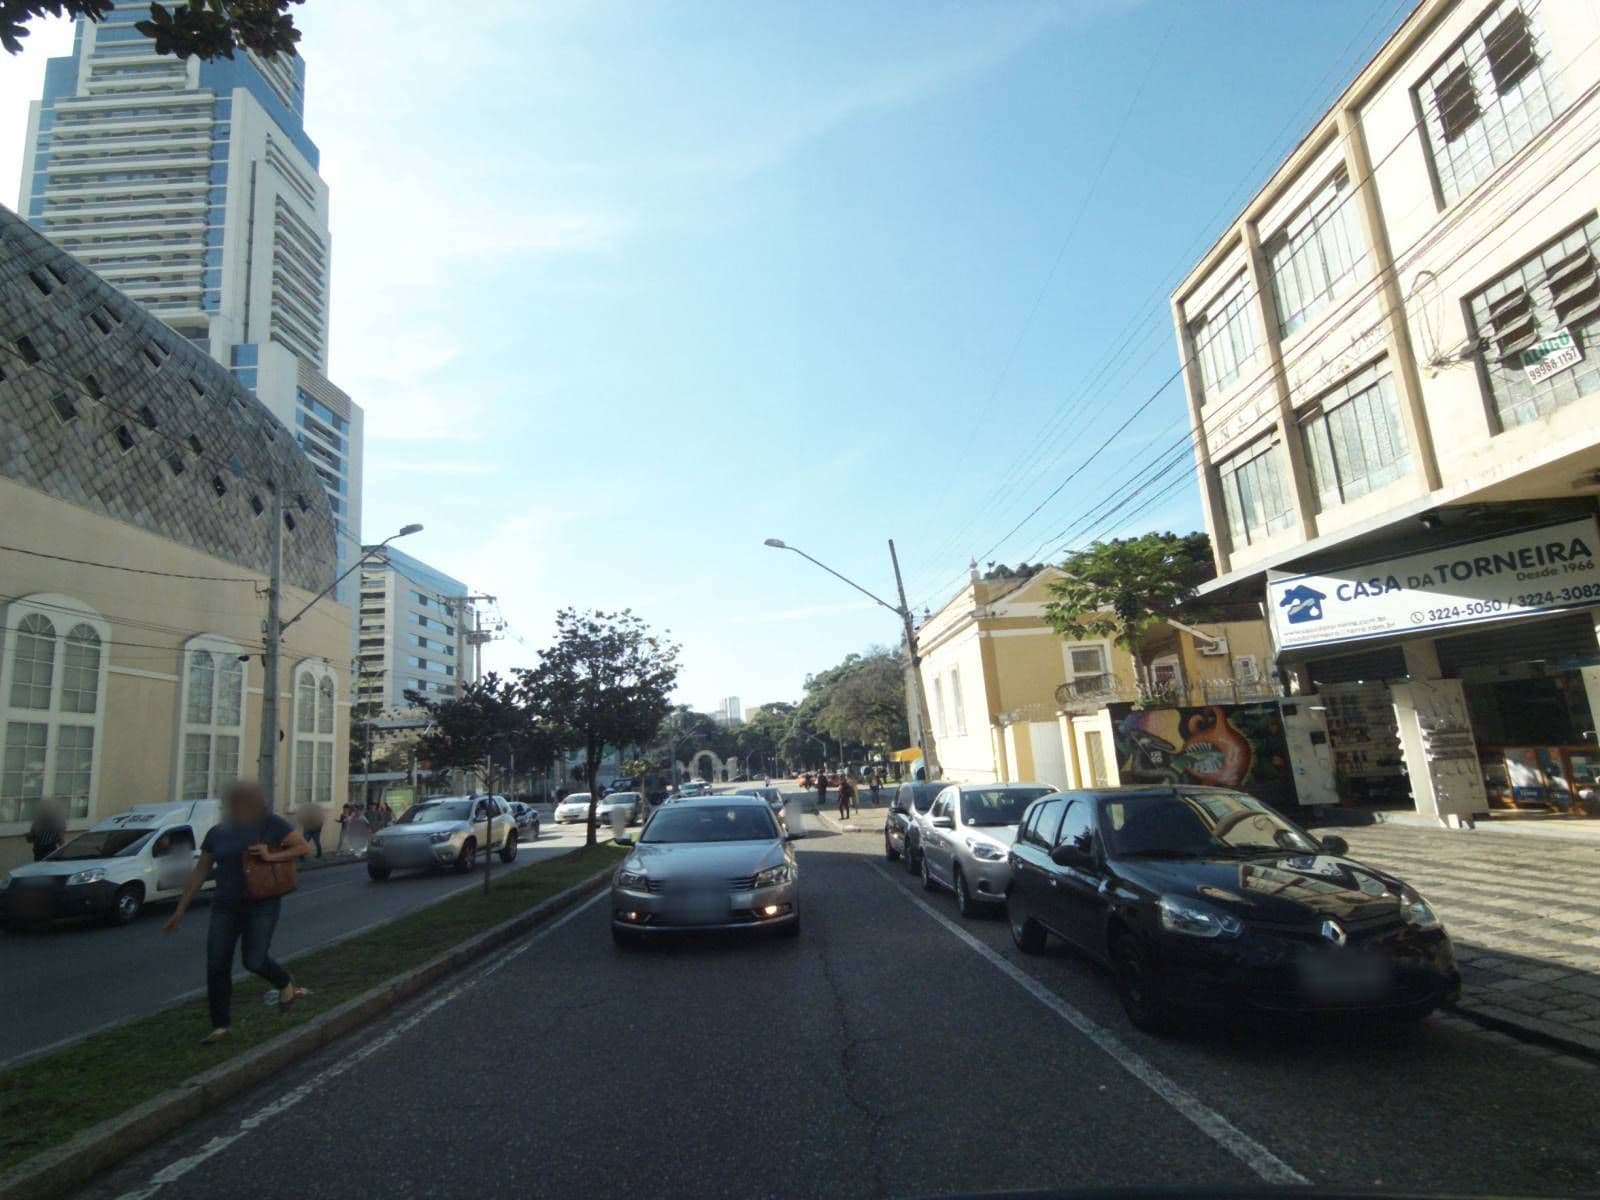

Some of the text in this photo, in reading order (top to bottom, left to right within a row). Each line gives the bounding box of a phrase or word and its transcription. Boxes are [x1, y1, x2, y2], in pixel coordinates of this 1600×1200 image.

[1524, 331, 1570, 366] ALUGO
[1336, 538, 1593, 602] CASA DA TORNEIRA
[1516, 560, 1595, 582] Desde 1966
[1428, 599, 1502, 621] 3224-5050
[1517, 583, 1600, 607] 3224-3082
